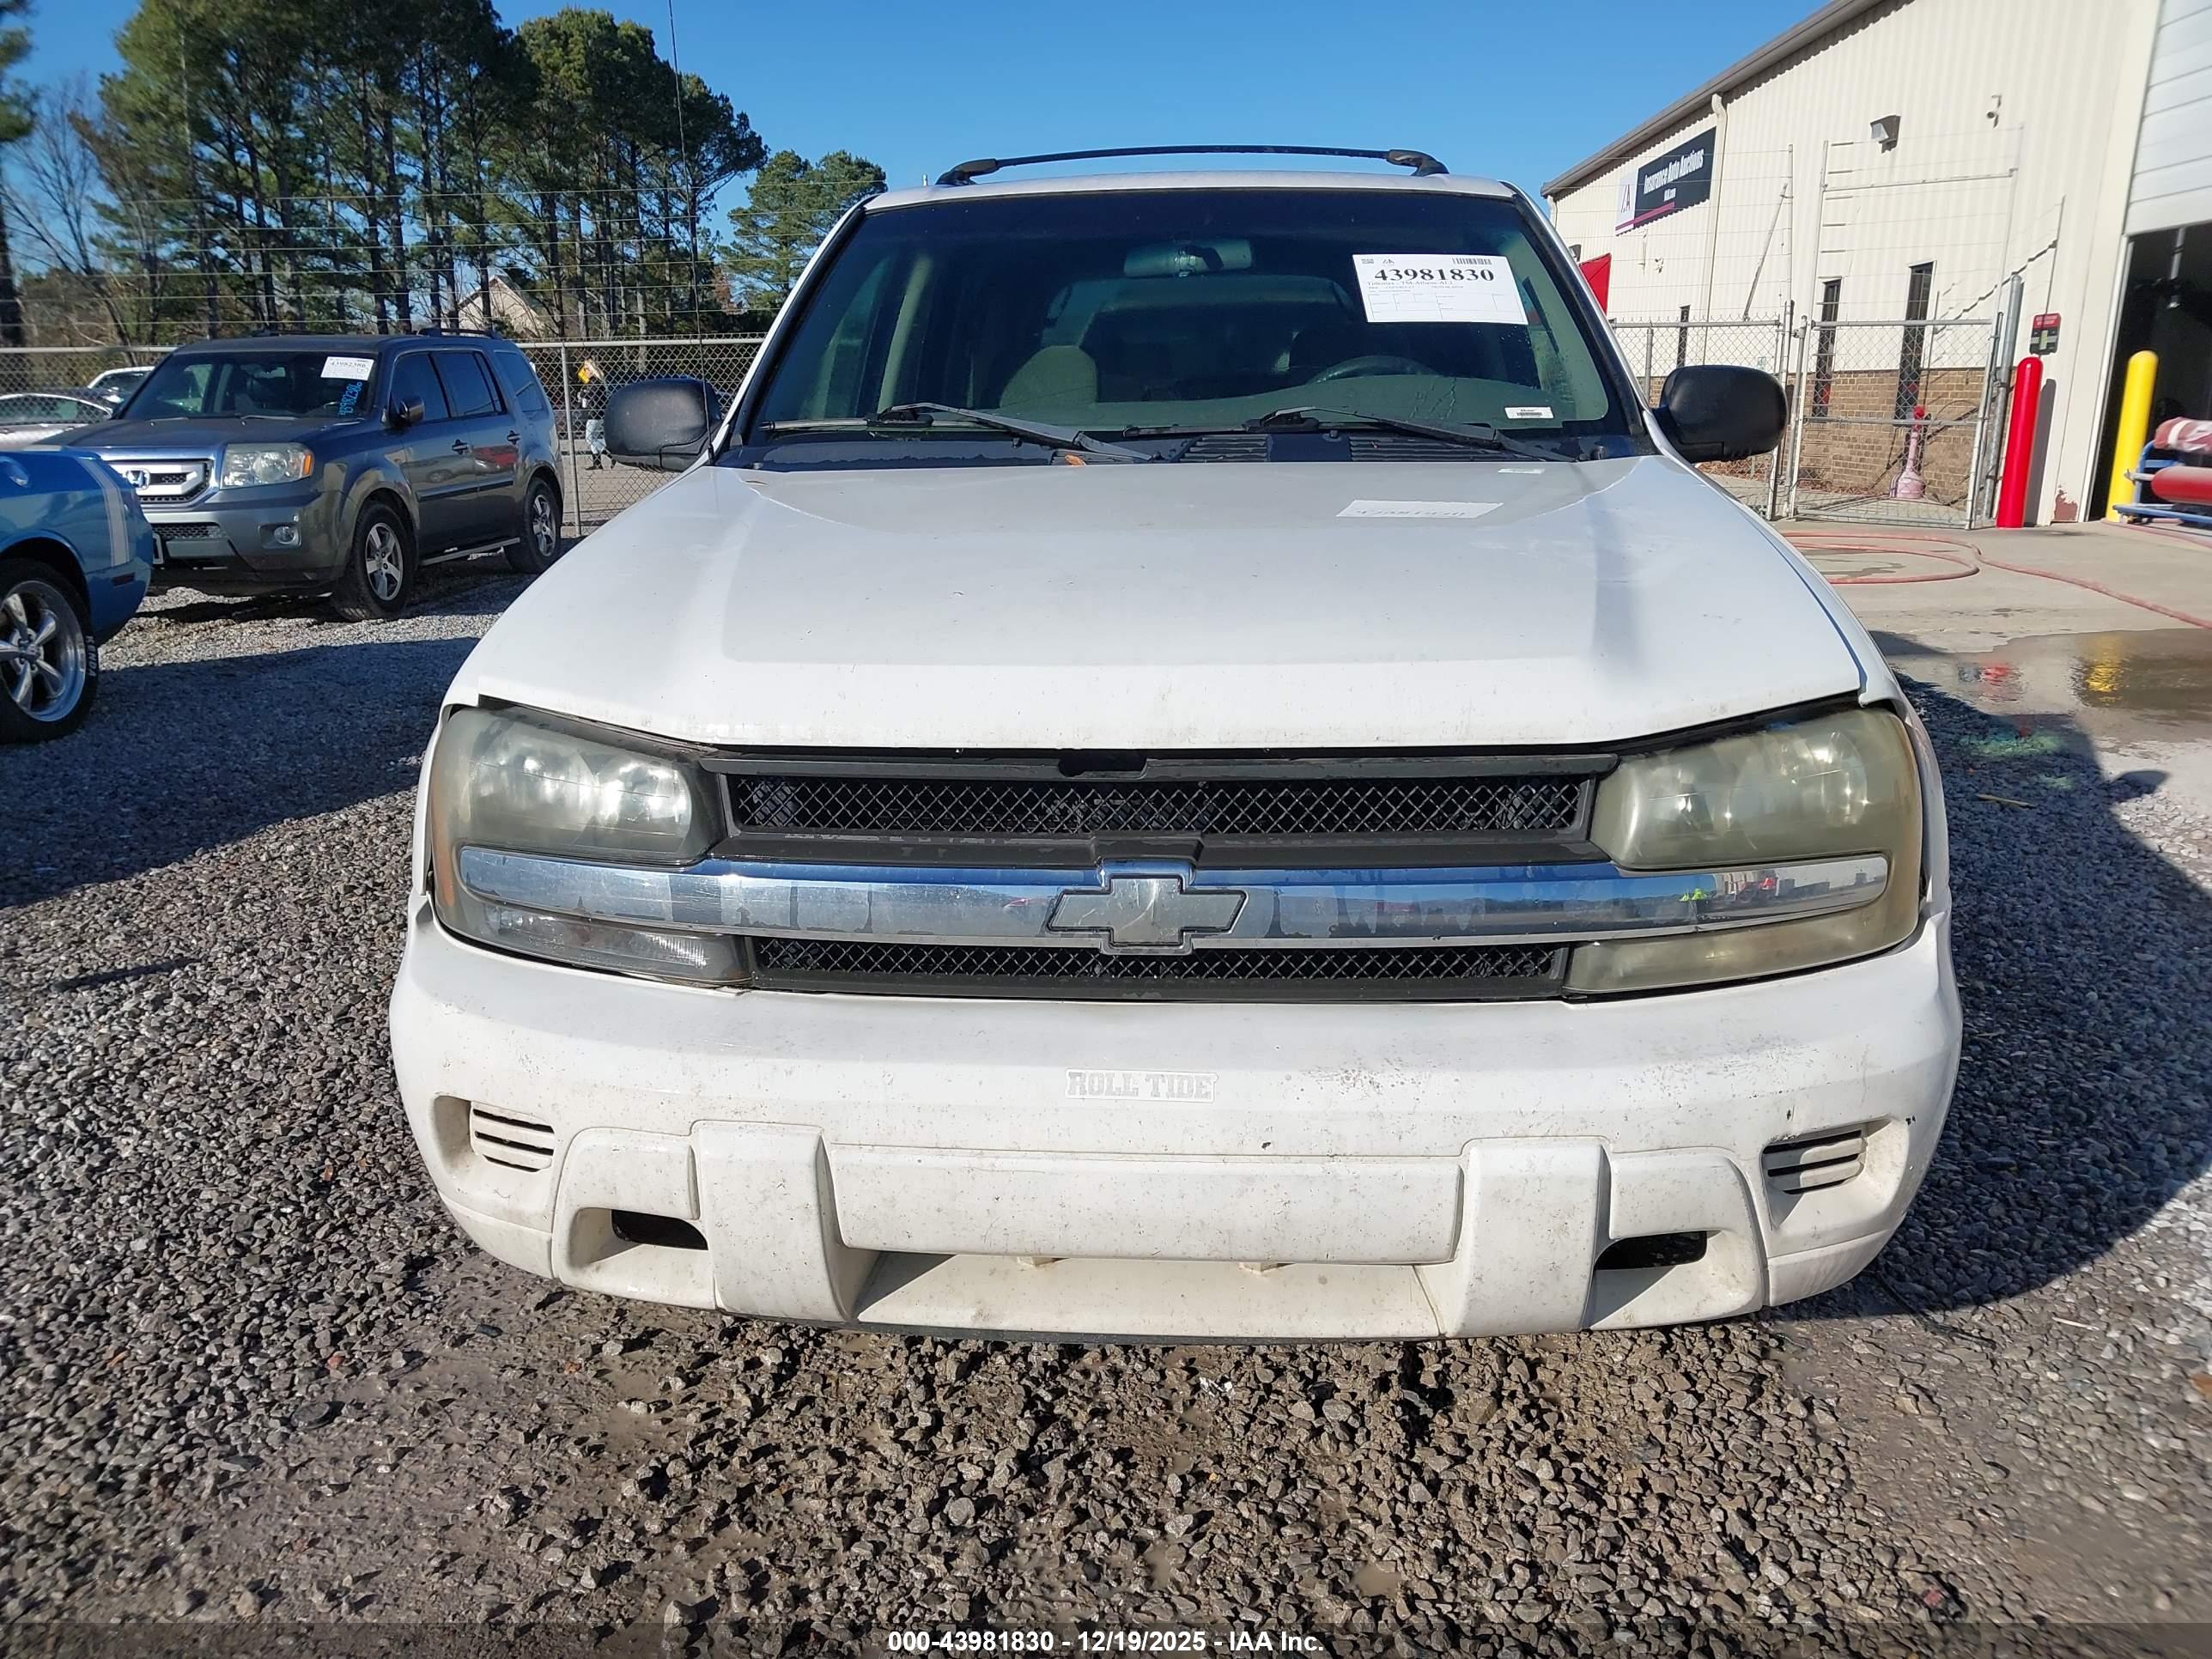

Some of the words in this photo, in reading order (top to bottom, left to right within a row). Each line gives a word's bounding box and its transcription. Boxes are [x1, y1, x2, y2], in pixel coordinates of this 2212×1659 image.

[1644, 167, 1668, 194] Insurance
[1668, 160, 1680, 183] Auto
[1679, 149, 1705, 178] Auctions
[1374, 268, 1494, 282] 43981830
[85, 635, 97, 677] KENDA
[1067, 1072, 1139, 1097] ROLL
[1145, 1073, 1212, 1099] TIDE
